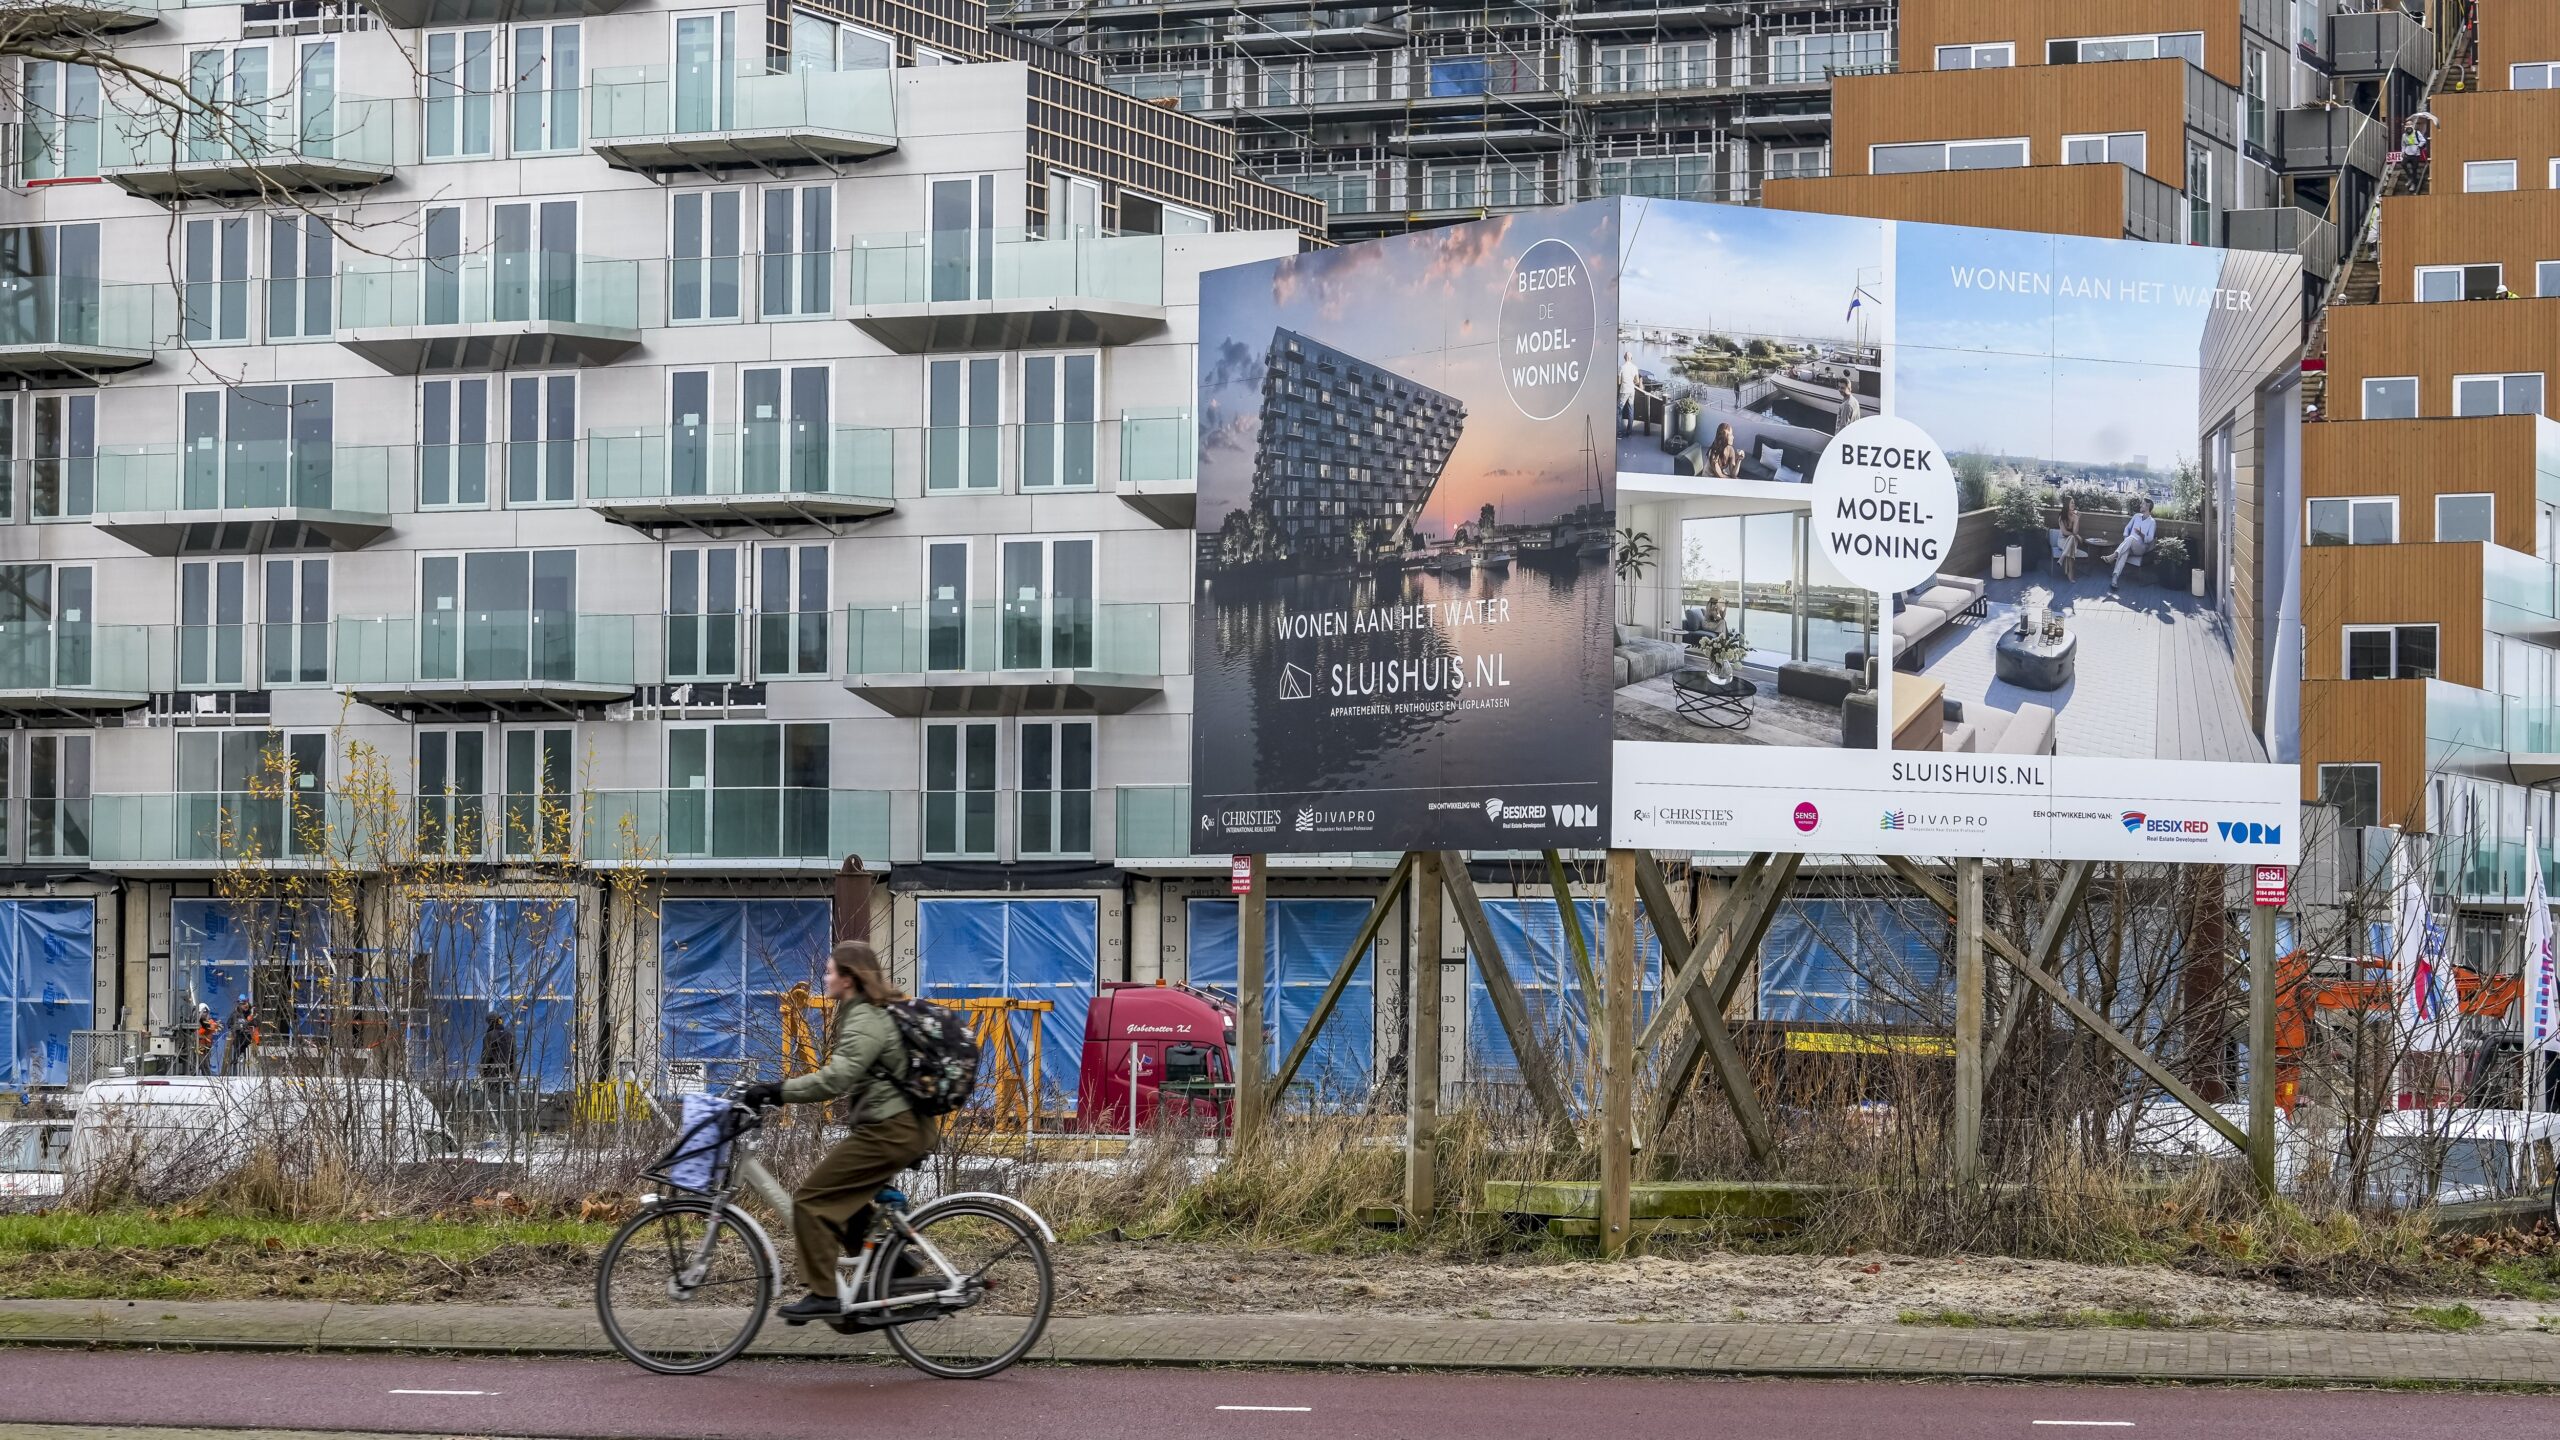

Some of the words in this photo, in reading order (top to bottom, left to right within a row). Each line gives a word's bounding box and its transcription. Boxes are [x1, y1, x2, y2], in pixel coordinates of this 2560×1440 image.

[1518, 264, 1576, 292] BEZOEK
[1950, 266, 2050, 295] WONEN
[2058, 276, 2111, 300] AAN
[2120, 280, 2164, 304] HET
[2172, 284, 2252, 312] WATER
[1539, 303, 1554, 320] DE
[1516, 328, 1576, 354] MODEL-
[1512, 361, 1579, 388] WONING
[1842, 444, 1931, 471] BEZOEK
[1874, 476, 1898, 494] DE
[1837, 496, 1933, 524] MODEL-
[1832, 532, 1938, 560] WONING
[1277, 611, 1348, 640] WONEN
[1354, 608, 1394, 634] AAN
[1402, 604, 1436, 629] HET
[1444, 598, 1510, 626] WATER
[1330, 654, 1510, 697] SLUISHUIS.NL
[1330, 704, 1393, 717] APPARTEMENTEN,
[1395, 701, 1444, 714] PENTHOUSES
[1446, 700, 1456, 710] EN
[1459, 698, 1510, 710] LIGPLAATSEN
[1892, 762, 2044, 786] SLUISHUIS.NL
[1222, 810, 1281, 826] CHRISTIE'S
[1316, 810, 1375, 824] DIVAPRO
[1552, 804, 1598, 828] VORM
[1660, 808, 1734, 821] CHRISTIE'S
[1795, 812, 1816, 820] SENSE
[1908, 814, 1988, 826] DIVAPRO
[2046, 811, 2096, 820] ONTWIKKELING
[2216, 821, 2281, 844] VORM
[1126, 1024, 1174, 1034] Globetrotter
[1176, 1024, 1192, 1033] XL
